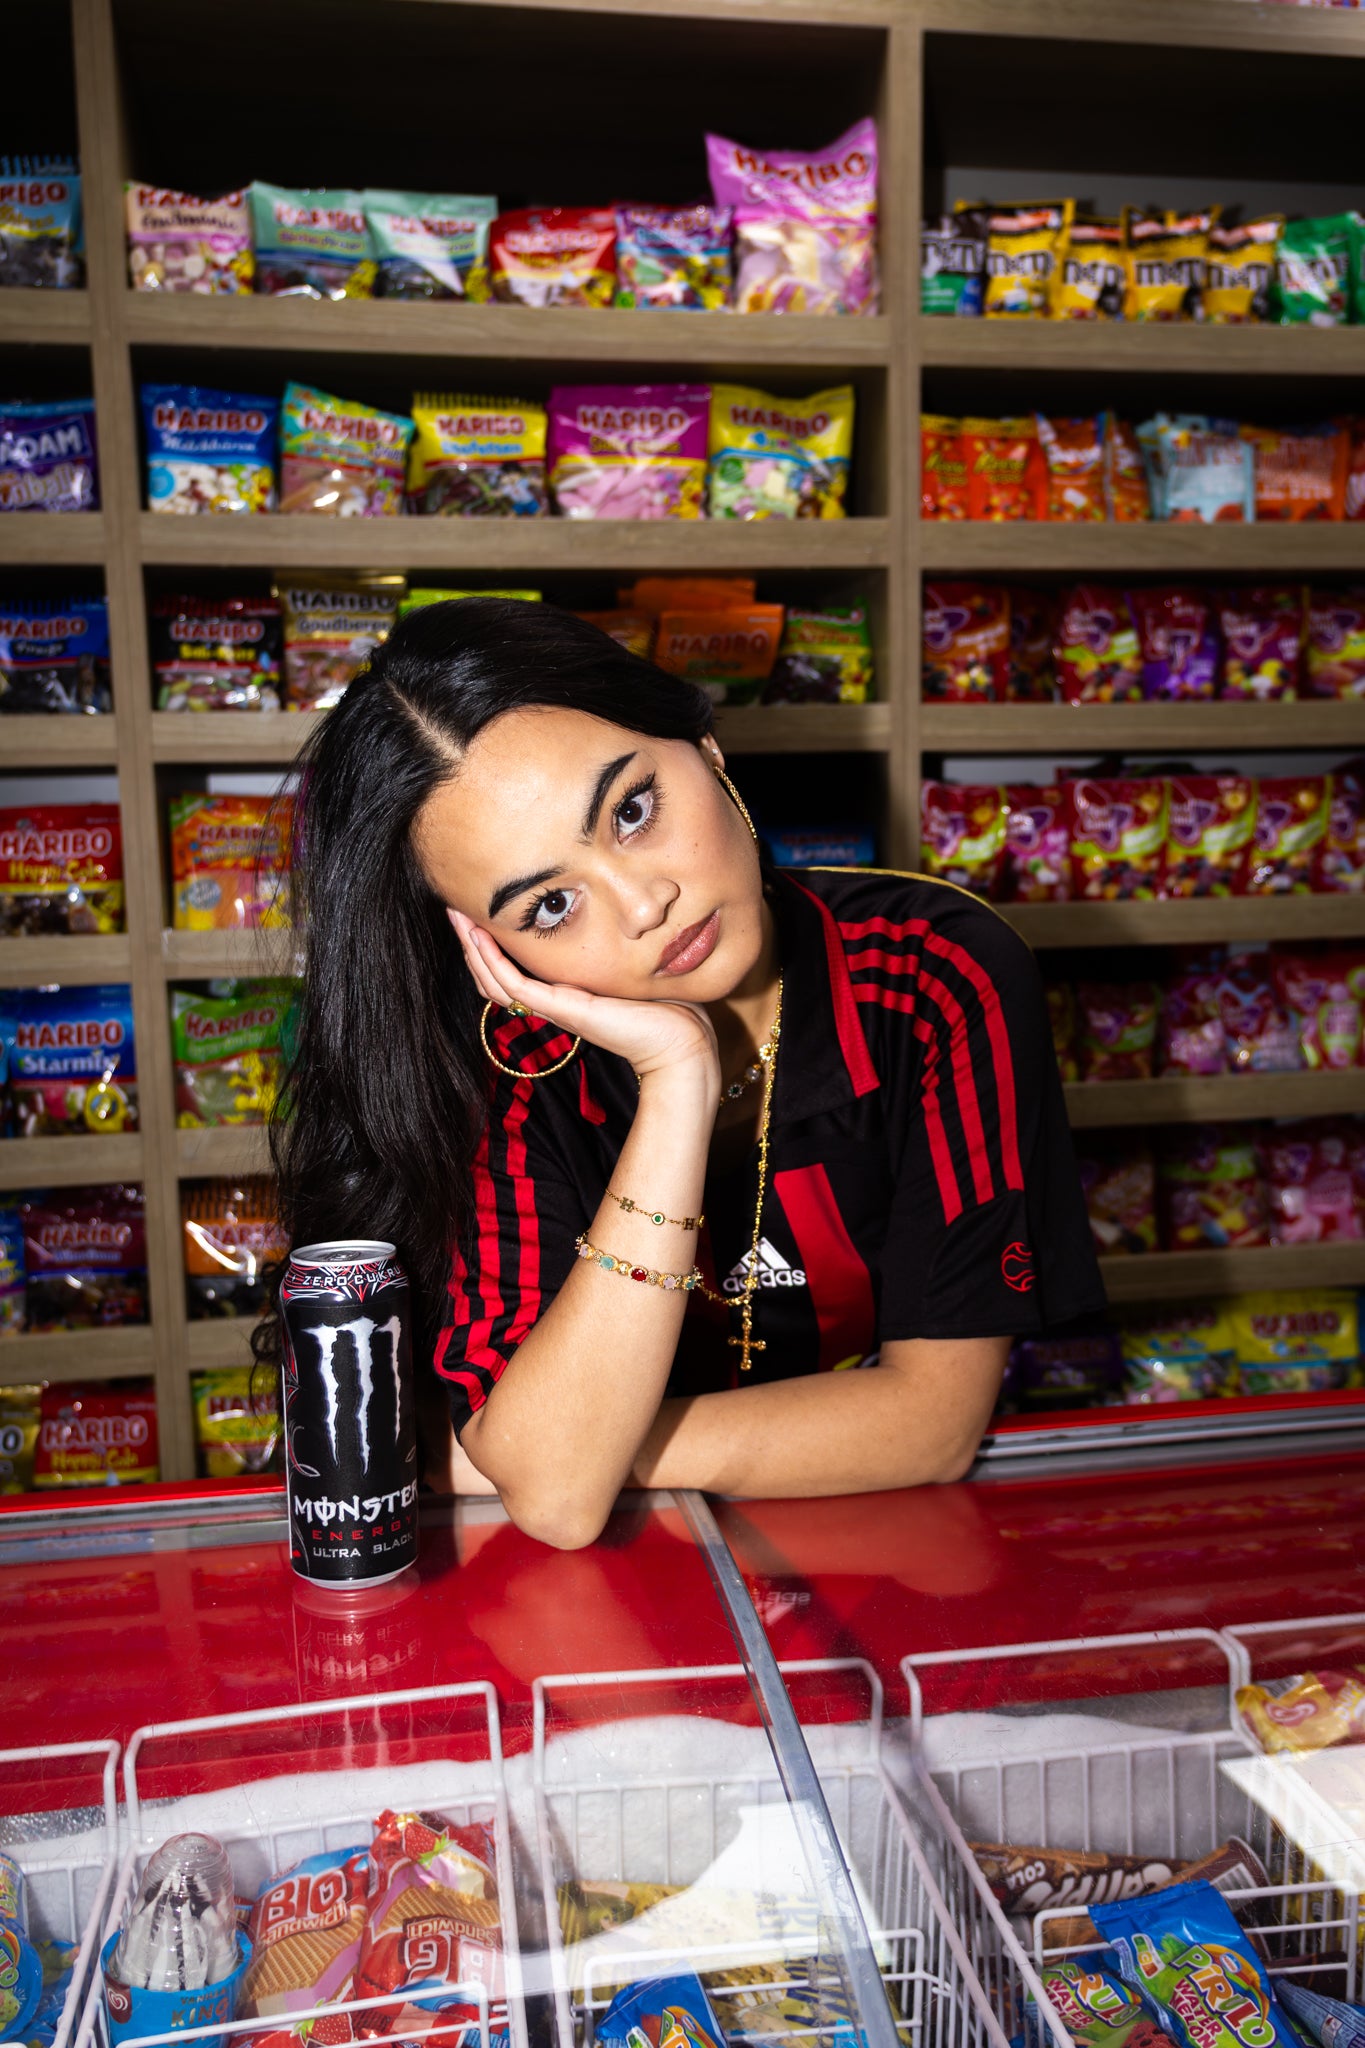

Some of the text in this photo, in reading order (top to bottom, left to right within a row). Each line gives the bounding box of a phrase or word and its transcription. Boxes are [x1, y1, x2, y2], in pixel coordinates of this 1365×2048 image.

[156, 406, 268, 432] HARIBO
[303, 409, 399, 443] HARIBO
[436, 416, 526, 436] HARIBO
[577, 406, 691, 434] HARIBO
[730, 405, 831, 436] HARIBO
[289, 591, 395, 612] HARIBO
[0, 617, 87, 640] HARIBO
[171, 621, 264, 641] HARIBO
[669, 631, 769, 654] HARIBO
[1, 829, 110, 860] HARIBO
[16, 1021, 123, 1048] HARIBO
[187, 1008, 277, 1038] HARIBO
[42, 1223, 131, 1246] HARIBO
[302, 1265, 401, 1286] ZERO CUKRU
[723, 1268, 807, 1292] addas
[1251, 1311, 1339, 1338] HARIBO
[43, 1416, 149, 1448] HARIBO
[311, 1515, 412, 1541] ENERGY
[312, 1532, 414, 1559] ULTRA BLACK
[1005, 1860, 1047, 1890] COLA
[261, 1868, 348, 1928] BIG
[407, 1916, 498, 1948] Sandwich
[404, 1933, 497, 1984] BIG
[1046, 1978, 1096, 2024] WATER
[1173, 1977, 1224, 2038] WATER
[1168, 1990, 1218, 2048] MELON
